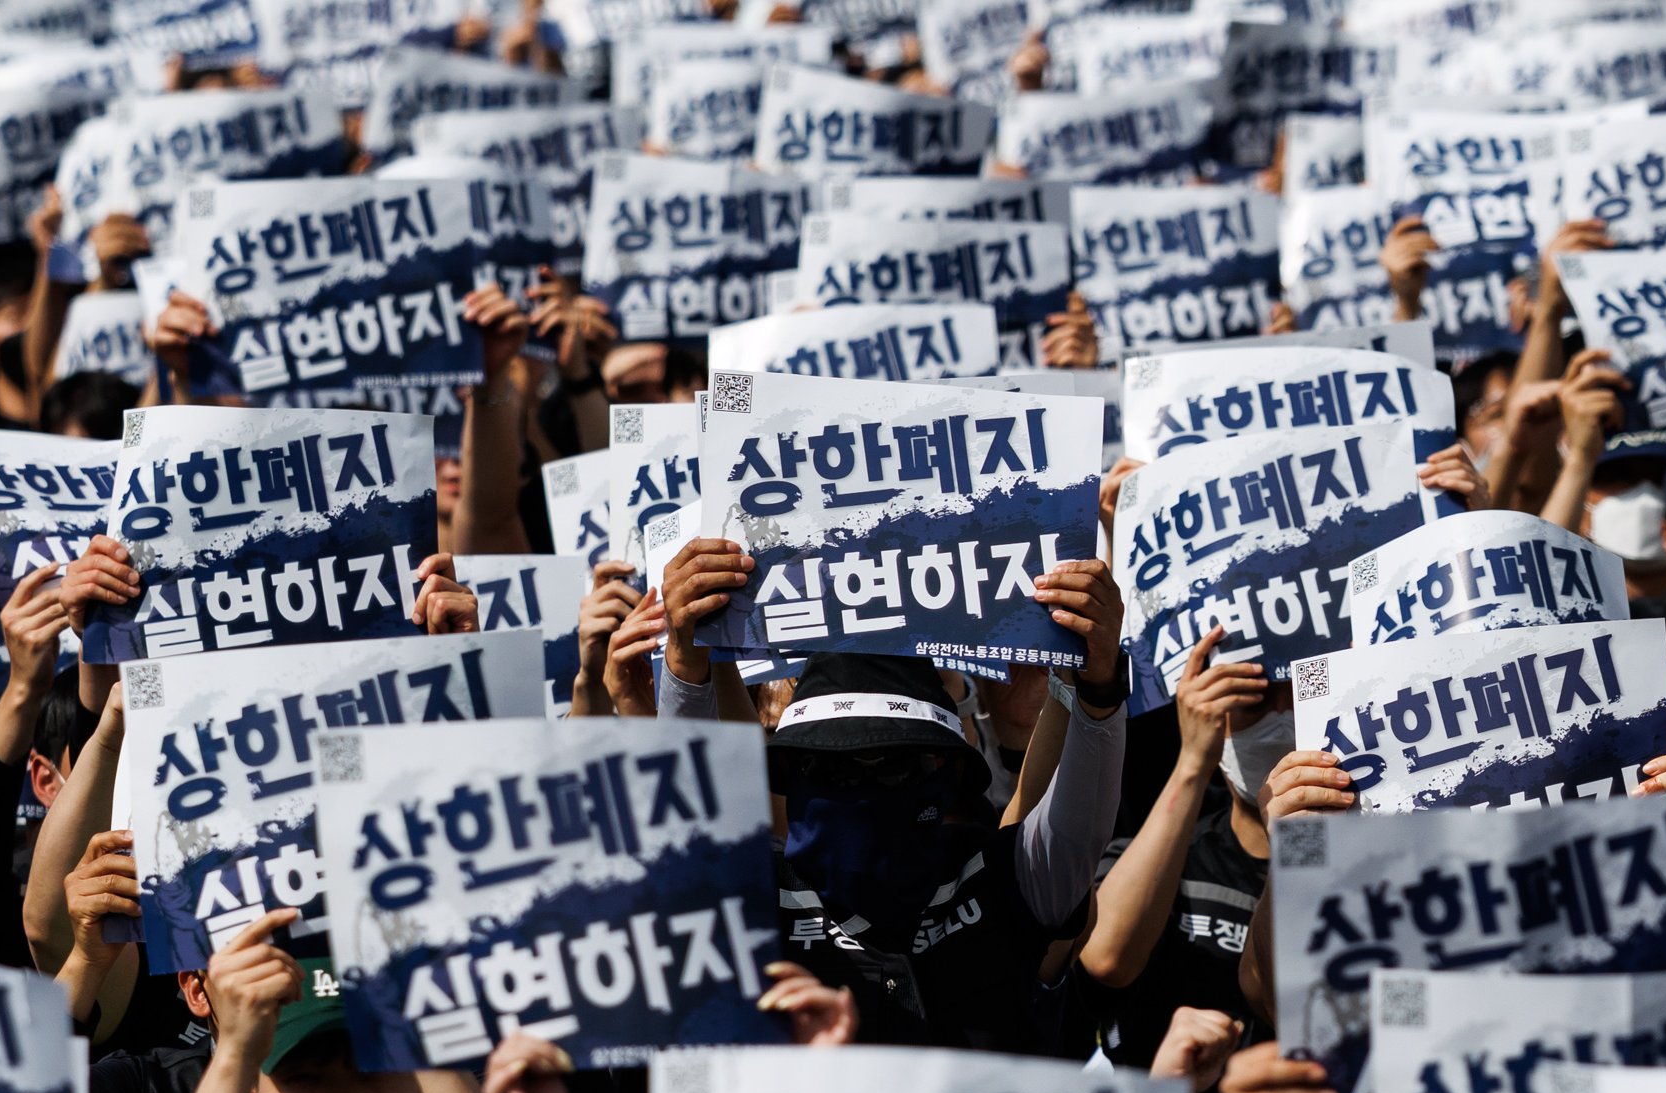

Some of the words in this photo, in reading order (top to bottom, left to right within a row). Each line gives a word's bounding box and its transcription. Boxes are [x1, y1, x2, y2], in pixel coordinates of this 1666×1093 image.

[783, 105, 961, 160] 상한폐지
[1406, 133, 1525, 178] 상한
[206, 187, 436, 296] 상한폐지
[612, 187, 811, 252] 상한폐지
[1425, 190, 1531, 243] 실현
[228, 283, 467, 390] 실현하자
[620, 272, 769, 340] 실현하
[763, 317, 963, 383] 한폐지
[728, 408, 1047, 517] 상한폐지
[1153, 367, 1417, 456] 상한폐지
[123, 423, 399, 541] 상한폐지
[1130, 437, 1373, 593] 상한폐지
[136, 543, 421, 655] 실현하자
[755, 532, 1067, 643] 실현하자
[1156, 558, 1353, 696] 실현하
[1370, 539, 1602, 648] 상한폐지
[916, 641, 1013, 660] 삼성전자노동조합
[1015, 648, 1085, 668] 공동투쟁본부
[1321, 633, 1625, 794] 상한폐지
[351, 738, 723, 912] 상한폐지
[193, 842, 326, 948] 실현
[912, 897, 981, 954] SELU
[1178, 913, 1248, 953] 투쟁
[312, 968, 339, 998] LA
[403, 896, 779, 1066] 실현하자
